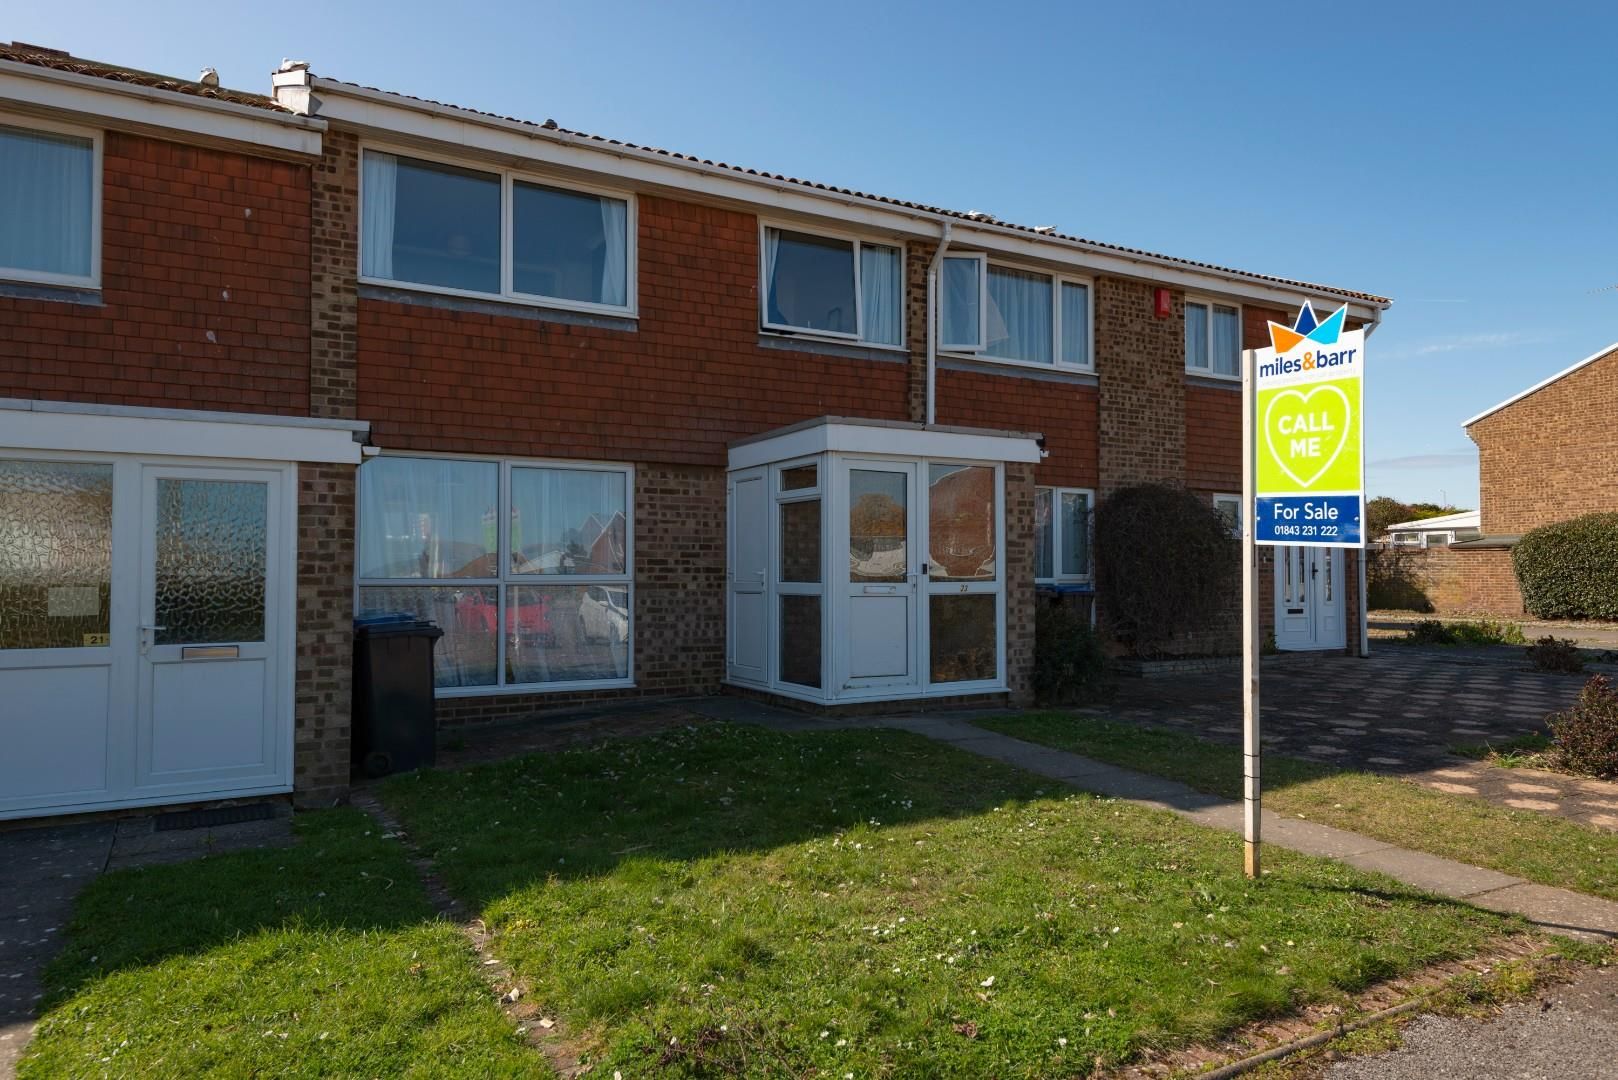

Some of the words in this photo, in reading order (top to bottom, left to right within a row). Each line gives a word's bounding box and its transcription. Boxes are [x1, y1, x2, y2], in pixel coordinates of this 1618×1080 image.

[1259, 348, 1357, 378] miles&barr
[1277, 411, 1335, 435] CALL
[1289, 436, 1321, 459] ME
[1274, 503, 1300, 520] For
[1304, 501, 1339, 520] Sale
[1274, 525, 1300, 536] 01843
[1302, 525, 1317, 536] 231
[1320, 525, 1338, 536] 222
[90, 636, 104, 644] 21
